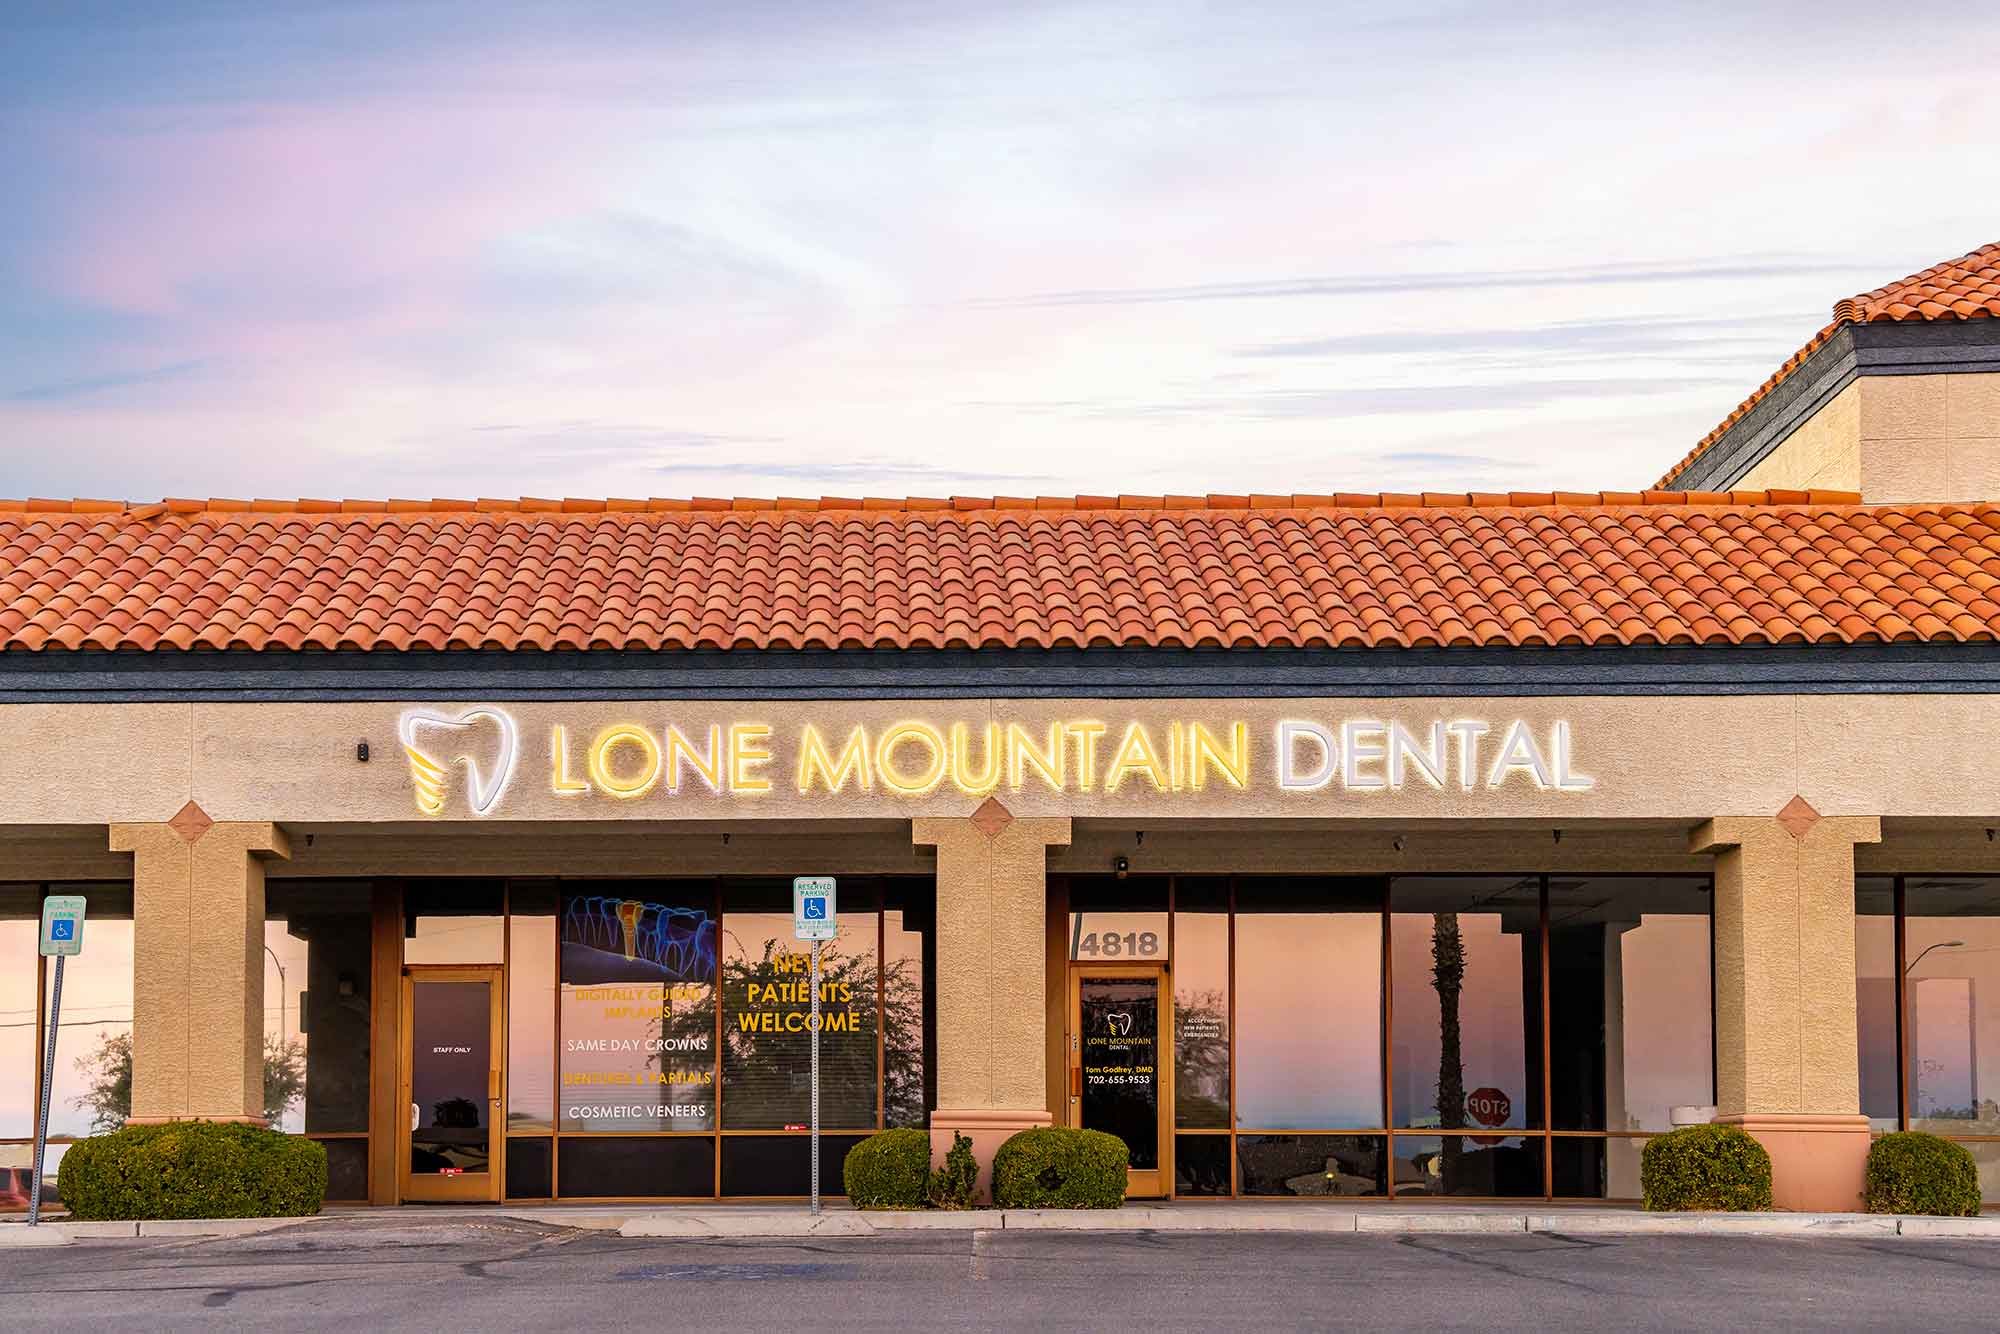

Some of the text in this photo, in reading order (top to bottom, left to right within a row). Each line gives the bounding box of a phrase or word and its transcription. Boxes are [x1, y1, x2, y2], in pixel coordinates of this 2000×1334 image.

[552, 719, 1594, 795] LONE MOUNTAIN DENTAL
[1079, 932, 1158, 956] 4818
[773, 953, 826, 973] NEW
[575, 989, 642, 1001] DIGITALLY
[748, 983, 851, 1002] PATIENTS
[604, 1006, 671, 1019] IMPLANTS
[738, 1012, 860, 1032] WELCOME
[567, 1038, 708, 1052] SAME DAY CROWNS
[1087, 1037, 1151, 1045] LONE MOUNTAIN
[563, 1072, 632, 1085] DENTURES
[648, 1071, 712, 1085] PARTIALS
[1088, 1075, 1150, 1084] 702-655-9533
[568, 1105, 706, 1119] COSMETIC VENEERS
